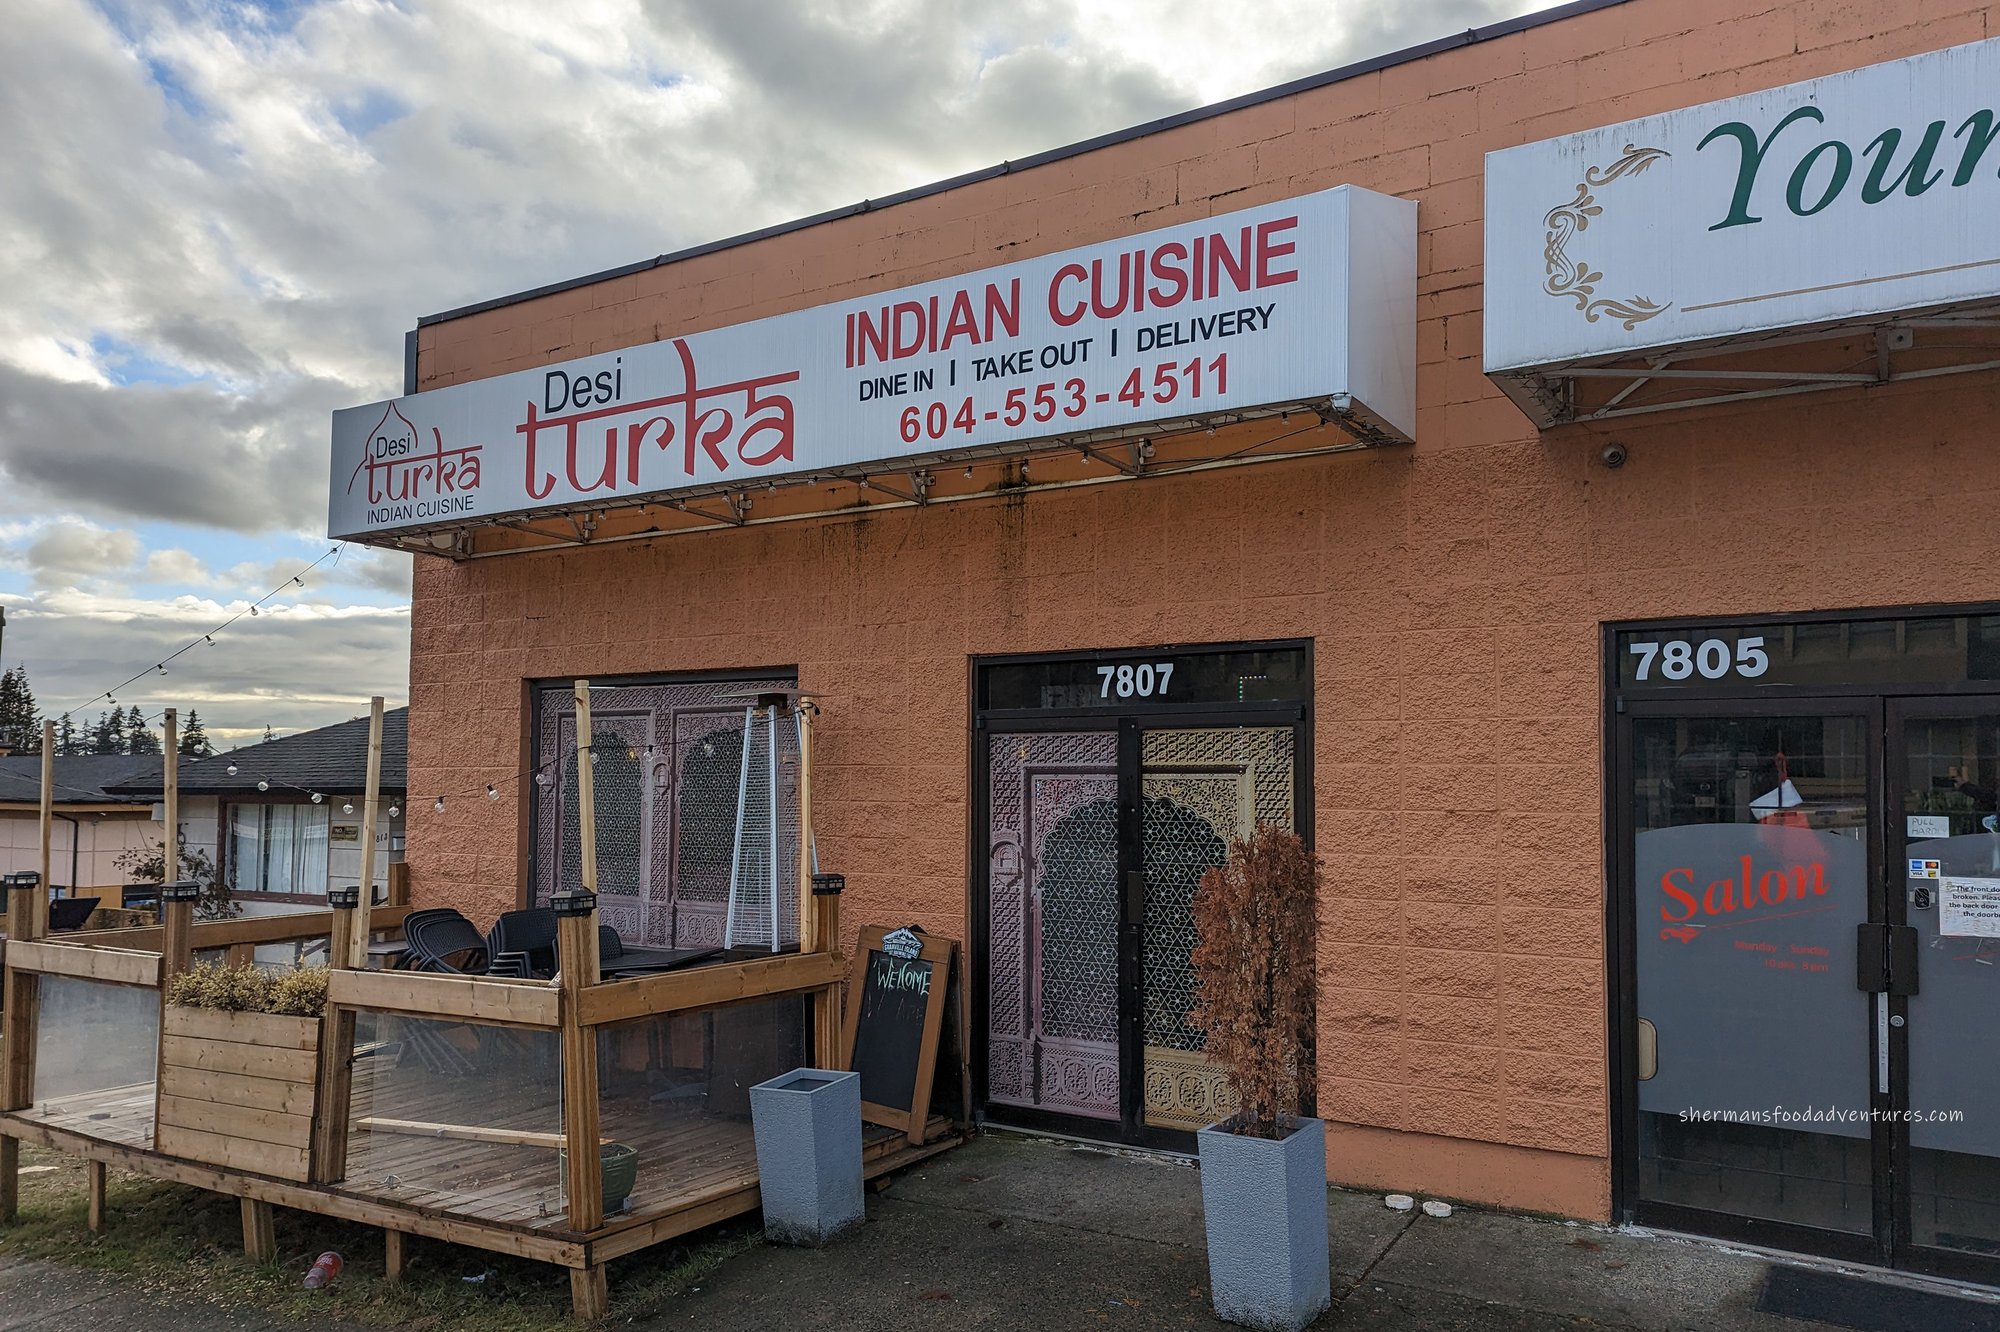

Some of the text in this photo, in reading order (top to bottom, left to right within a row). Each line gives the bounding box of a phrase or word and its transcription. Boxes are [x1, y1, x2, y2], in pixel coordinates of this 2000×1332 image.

[845, 216, 1298, 369] INDIAN CUISINE
[859, 373, 908, 401] DINE
[913, 367, 934, 392] IN
[972, 350, 1033, 382] TAKE
[1040, 338, 1093, 369] OUT
[1137, 303, 1276, 352] DELIVERY
[545, 357, 622, 414] Desi
[900, 352, 1228, 443] 604-553-4511
[376, 432, 410, 458] Desi
[516, 338, 800, 500] turka
[364, 427, 483, 505] turka
[367, 494, 474, 525] INDIAN CUISINE
[1097, 663, 1175, 699] 7807
[1630, 636, 1769, 681] 7805
[1911, 817, 1934, 826] PULL
[1660, 855, 1832, 922] Salon
